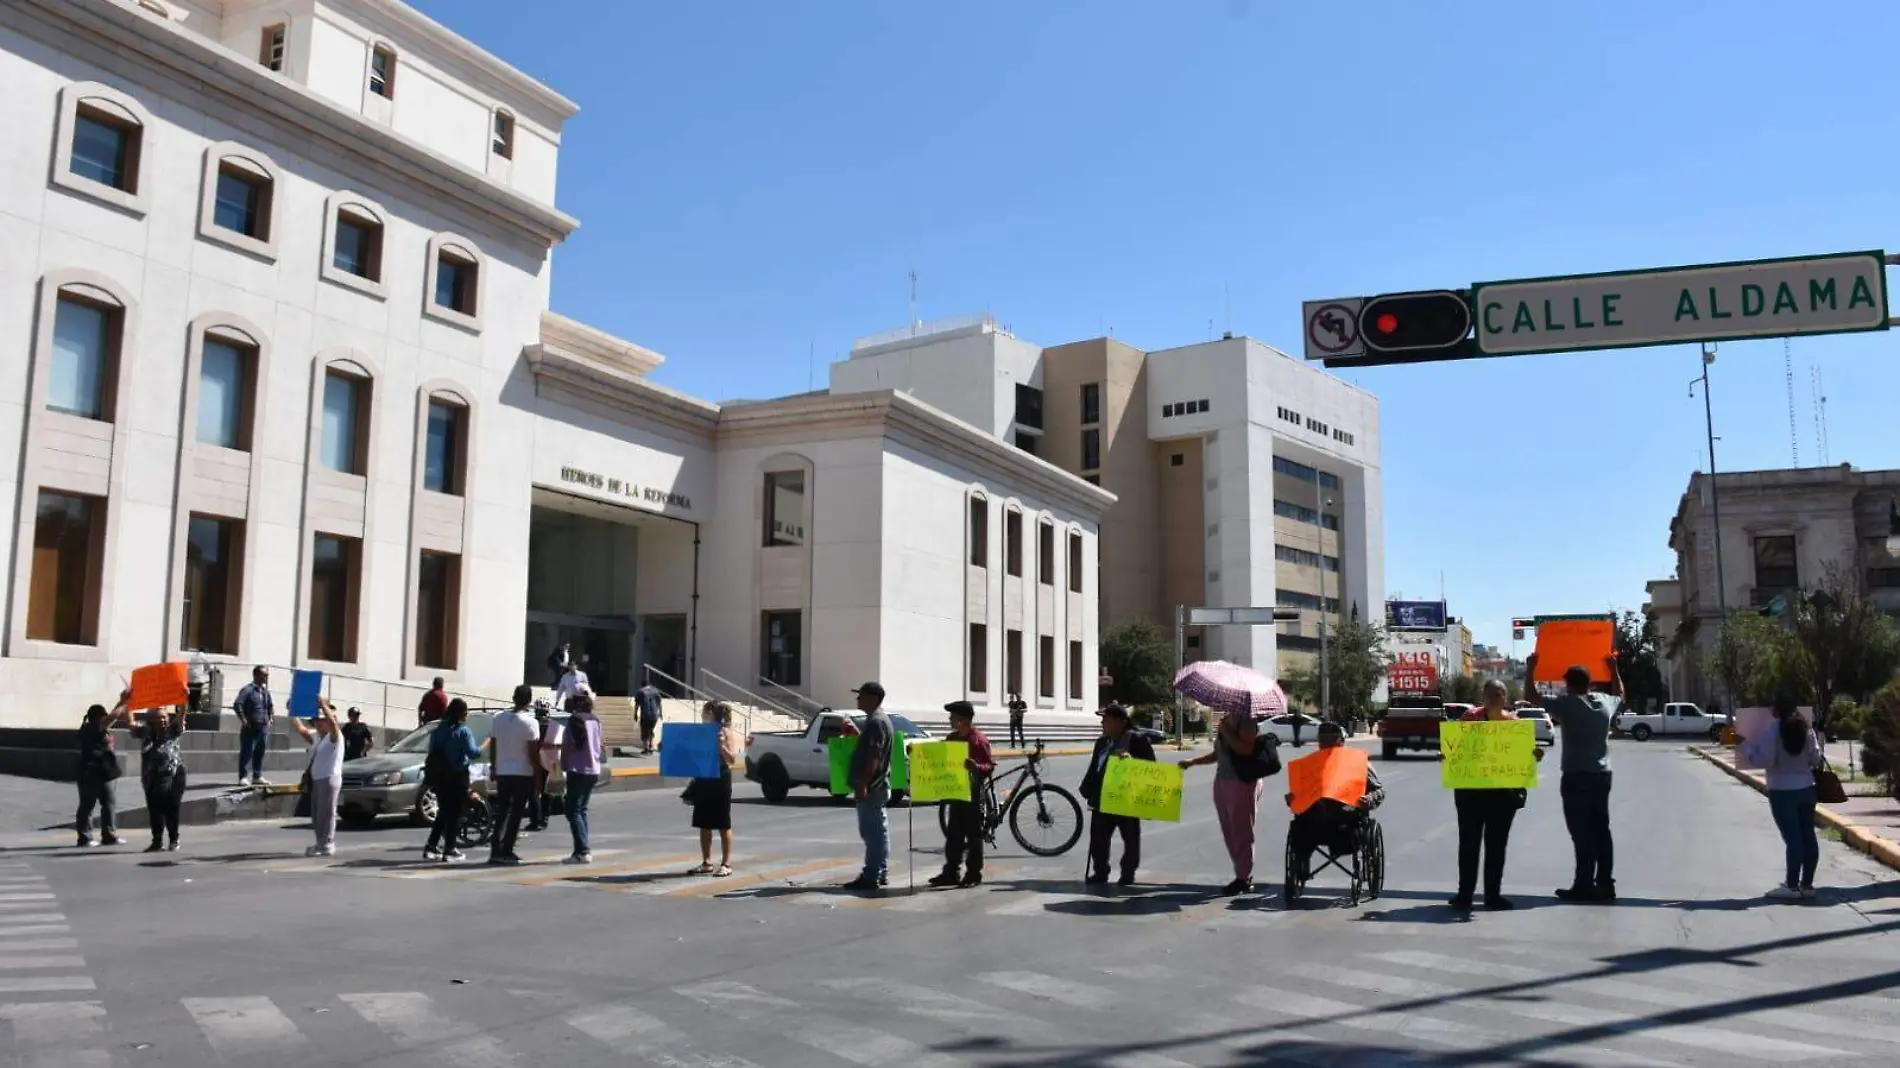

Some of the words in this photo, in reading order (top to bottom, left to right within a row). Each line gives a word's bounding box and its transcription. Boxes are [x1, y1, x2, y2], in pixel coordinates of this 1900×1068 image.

[1483, 294, 1623, 334] CALLE
[1673, 275, 1876, 322] ALDAMA
[608, 478, 622, 493] DE
[625, 482, 639, 498] LA
[644, 486, 692, 509] REFORMA
